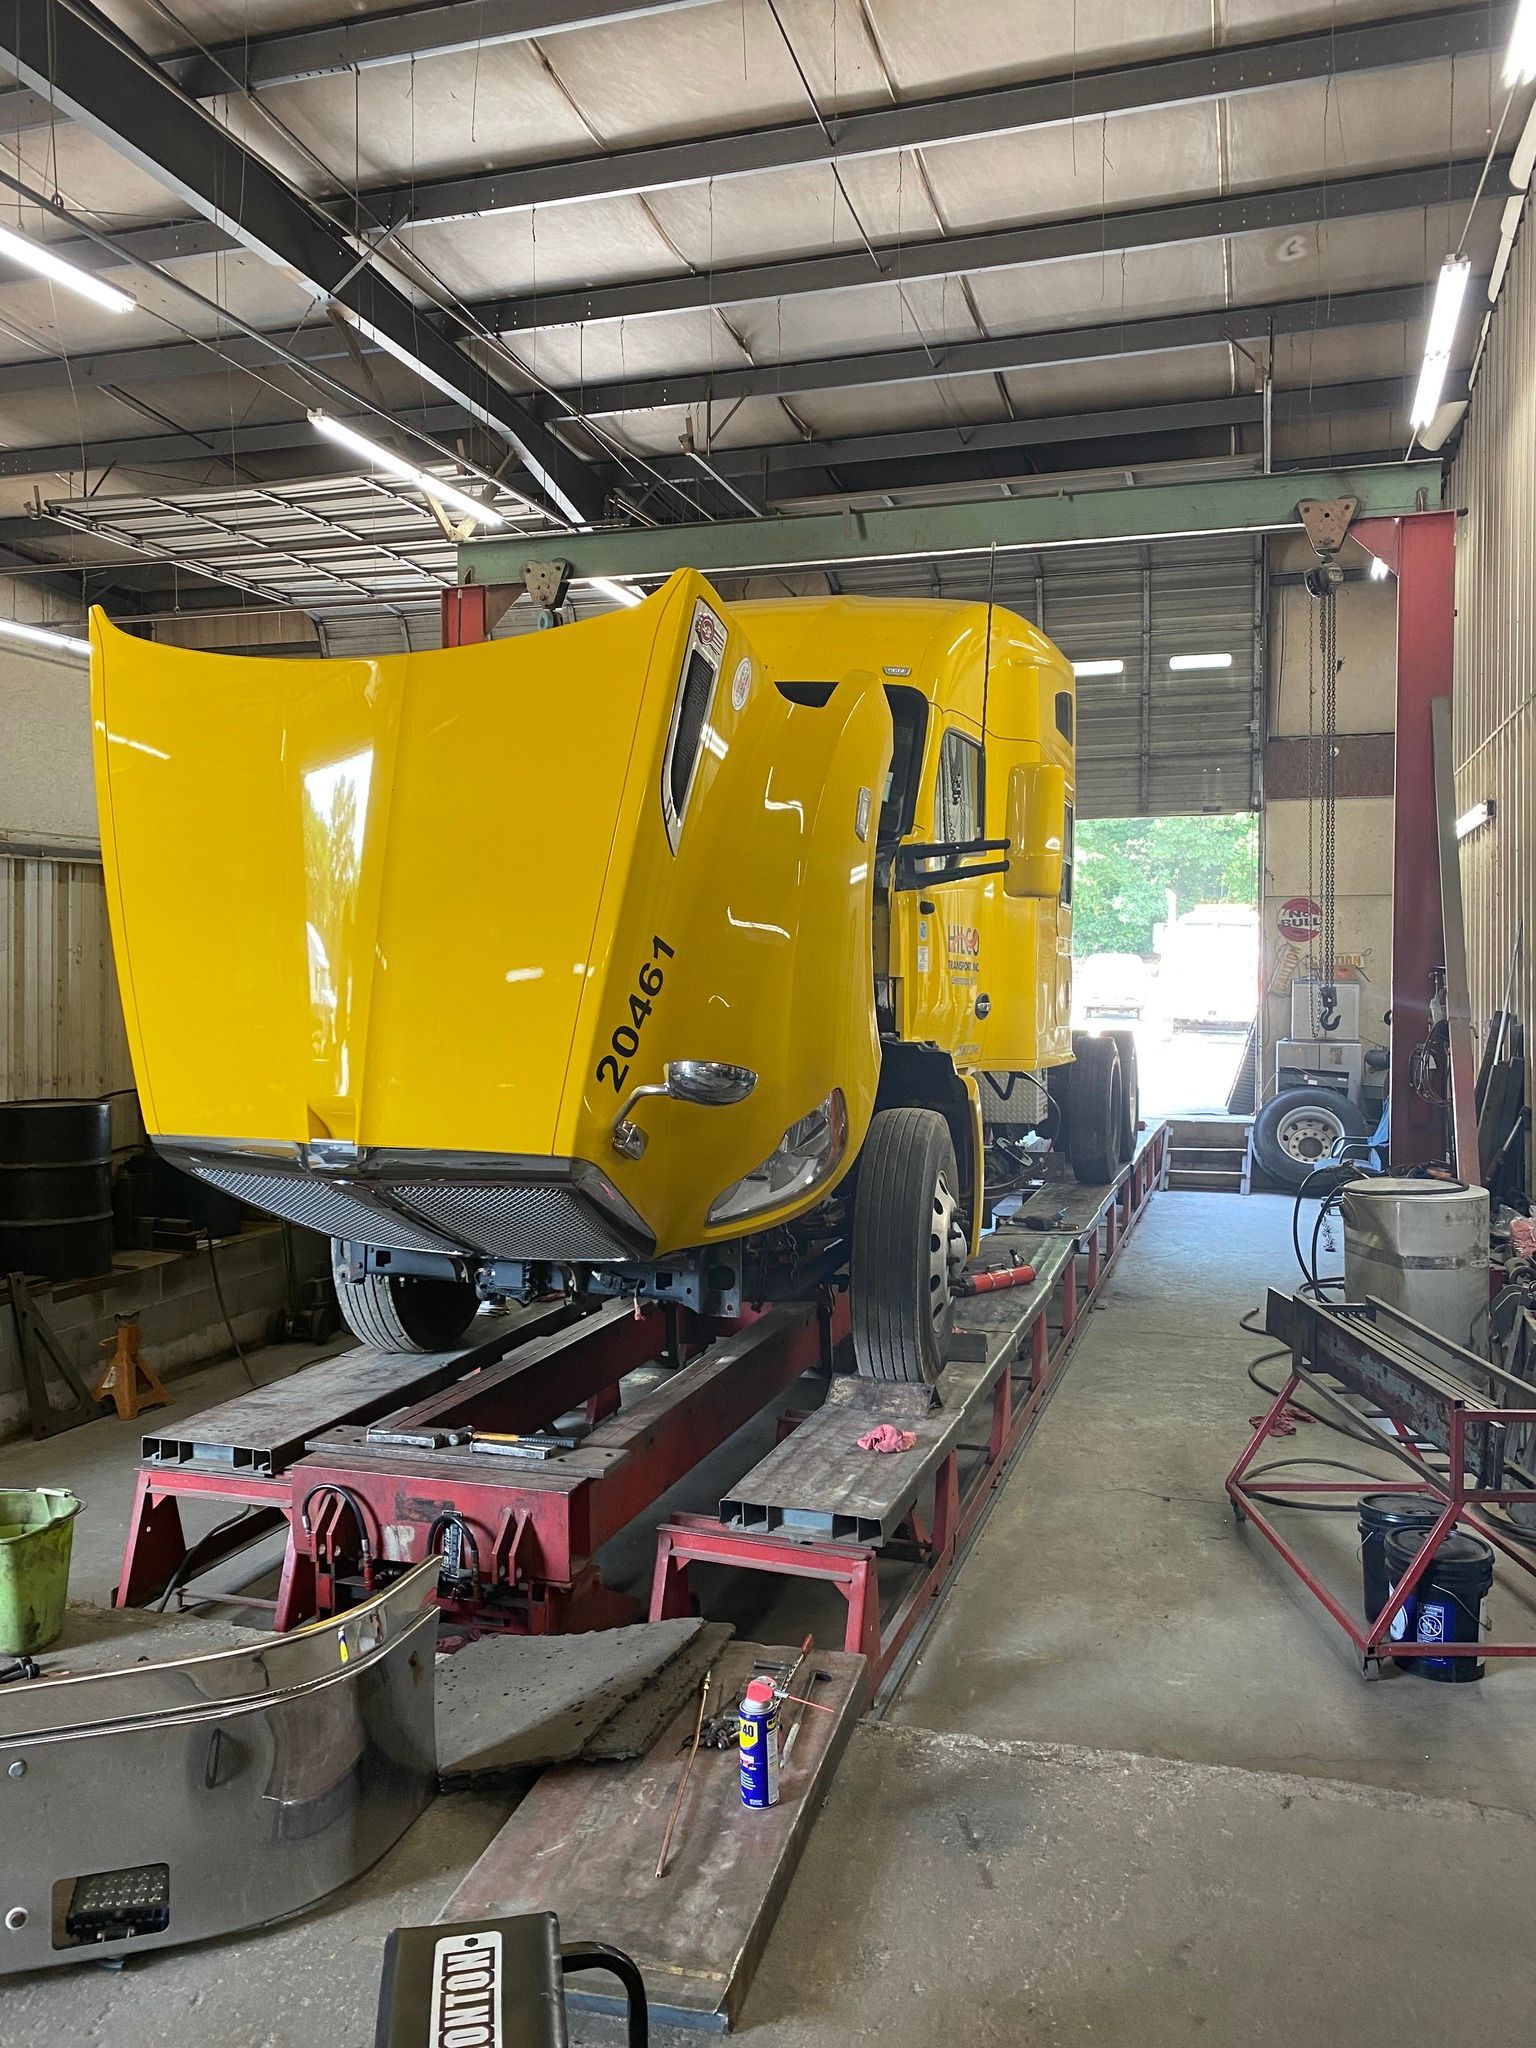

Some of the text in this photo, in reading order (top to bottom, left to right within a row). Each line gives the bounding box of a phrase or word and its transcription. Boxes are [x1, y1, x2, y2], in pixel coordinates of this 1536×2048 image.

[1281, 917, 1321, 928] BULL
[947, 924, 980, 956] HILCO
[595, 934, 676, 1094] 20461
[742, 1724, 754, 1737] 40
[438, 1946, 496, 2048] ONTON
